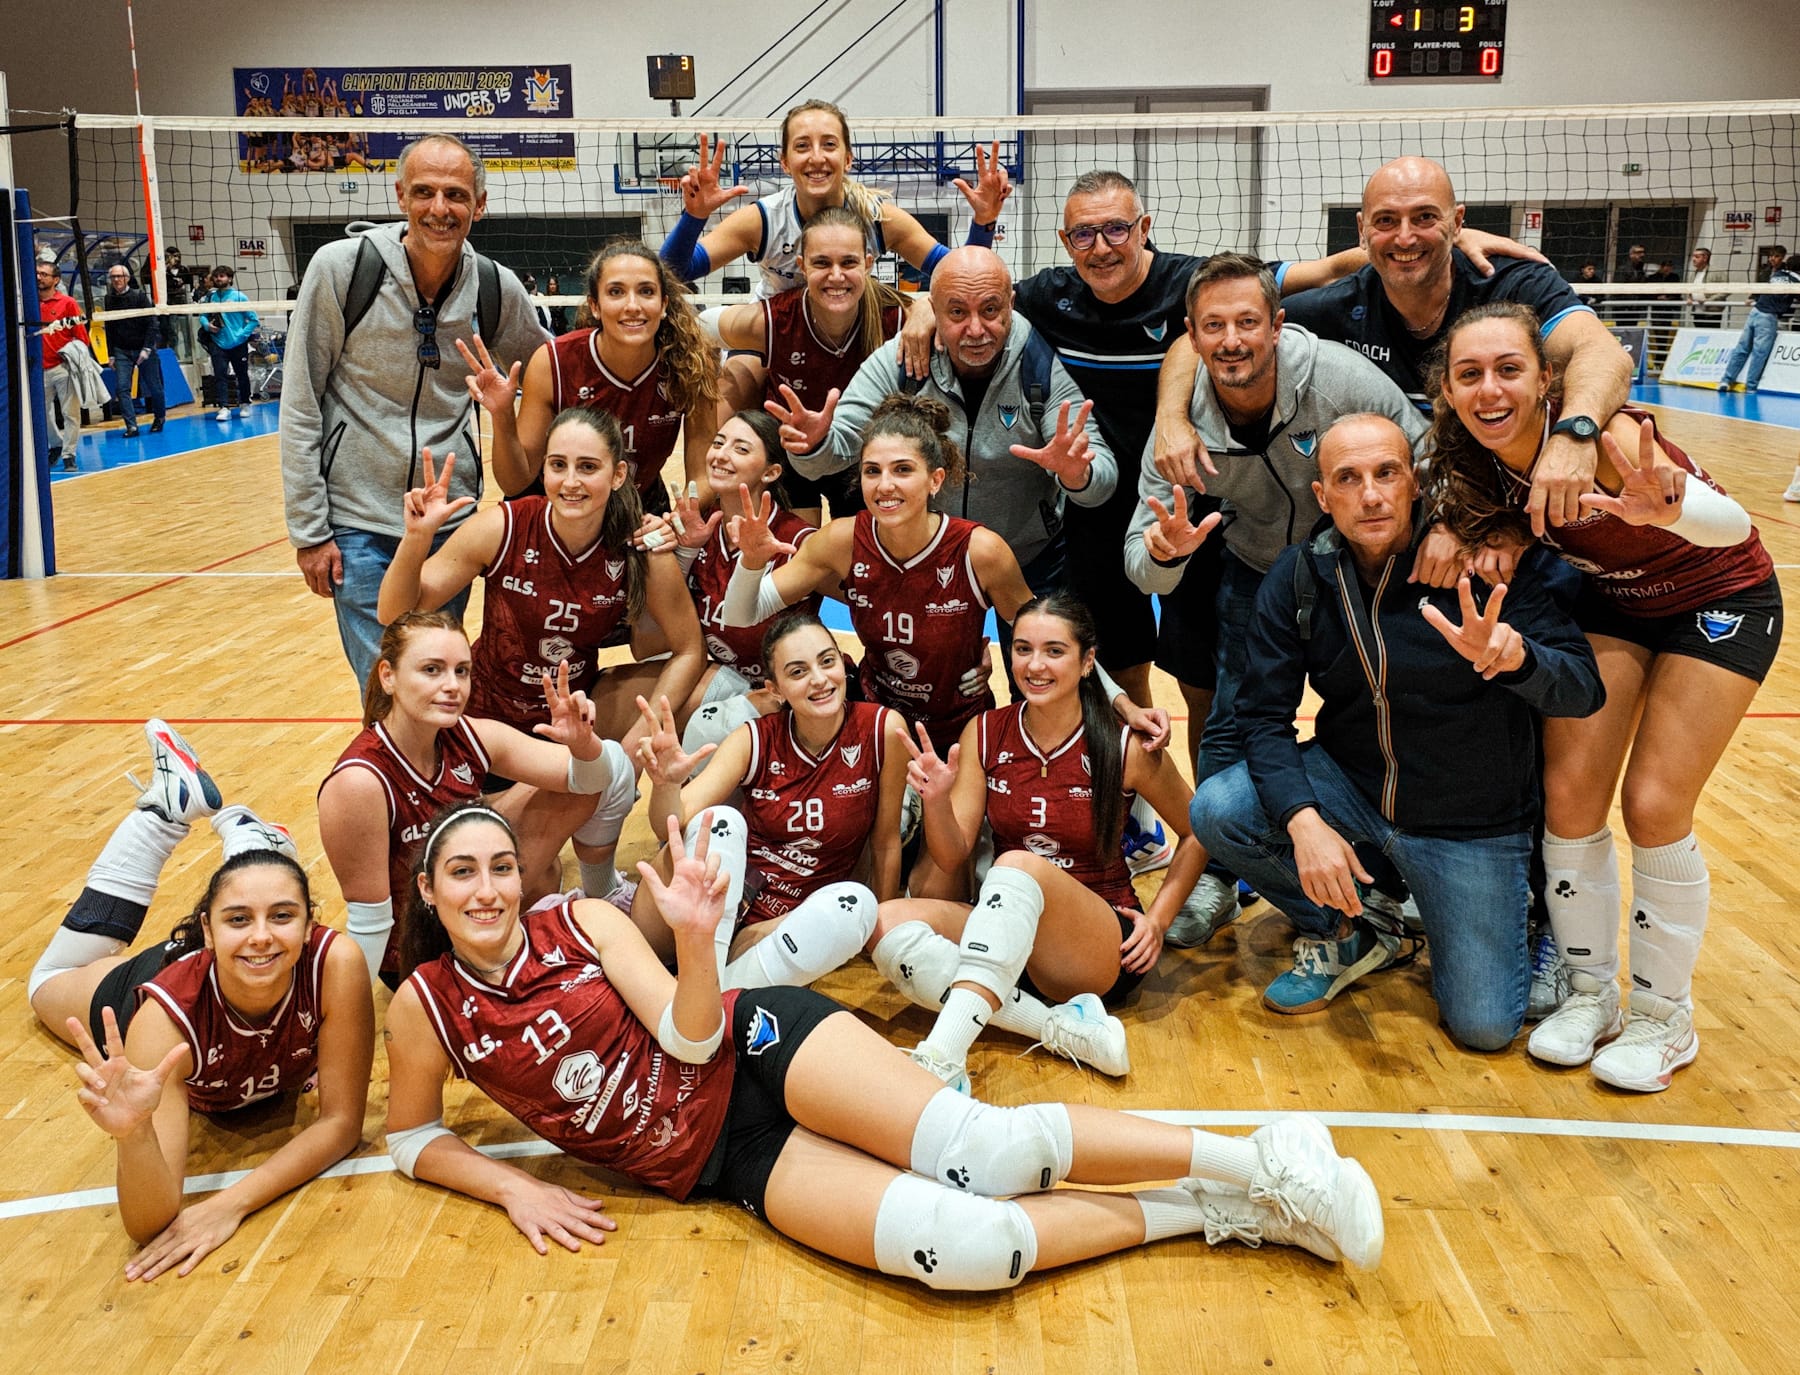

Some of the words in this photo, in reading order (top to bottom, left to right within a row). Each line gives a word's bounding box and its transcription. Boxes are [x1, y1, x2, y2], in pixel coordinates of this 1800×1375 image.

[1460, 7, 1474, 32] 3
[1414, 41, 1461, 49] PLAYER-FOUL
[680, 56, 689, 70] 3
[1375, 50, 1391, 75] 0
[1482, 48, 1498, 74] 0
[342, 73, 407, 91] CAMPIONI
[408, 72, 475, 91] REGIONALI
[477, 71, 513, 90] 2023
[443, 90, 490, 110] UNDER
[494, 88, 511, 103] 15
[465, 102, 495, 117] GOLD
[1726, 213, 1753, 222] BAR
[239, 240, 265, 249] BAR
[544, 599, 582, 633] 25
[882, 611, 914, 645] 19
[522, 660, 586, 678] SANTRO
[786, 797, 825, 833] 28
[1029, 797, 1048, 828] 3
[521, 1008, 572, 1066] 13
